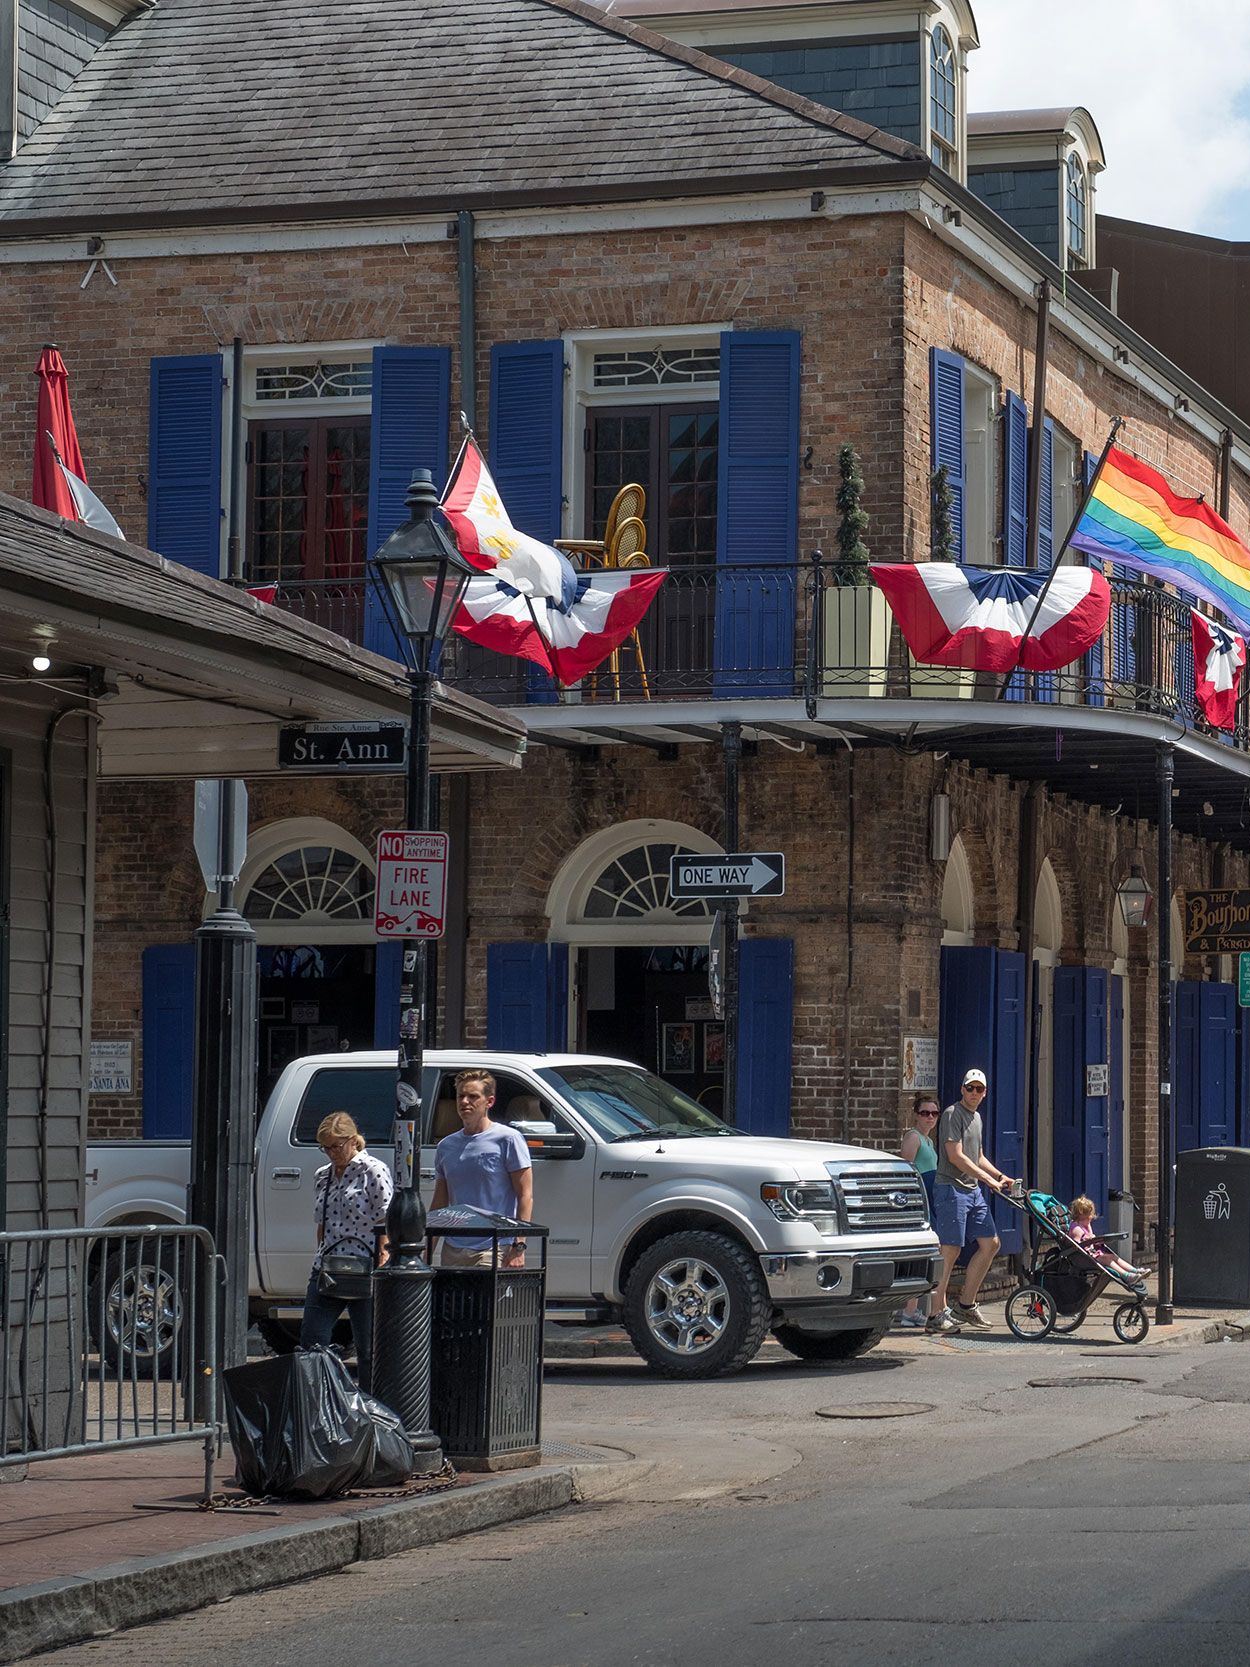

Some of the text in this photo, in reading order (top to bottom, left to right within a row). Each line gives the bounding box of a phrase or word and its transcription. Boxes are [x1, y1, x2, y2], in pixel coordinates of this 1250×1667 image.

[313, 724, 329, 732] Rue
[350, 723, 372, 732] Anne
[293, 736, 390, 760] St. Ann
[380, 836, 446, 857] NO STOPPING
[406, 848, 441, 858] ANYTIME
[394, 867, 429, 884] FIRE
[683, 866, 750, 884] ONE WAY
[390, 889, 431, 907] LANE
[1209, 893, 1229, 903] THE
[1200, 938, 1210, 950] &
[115, 1076, 130, 1090] ANA
[599, 1171, 635, 1180] F-150
